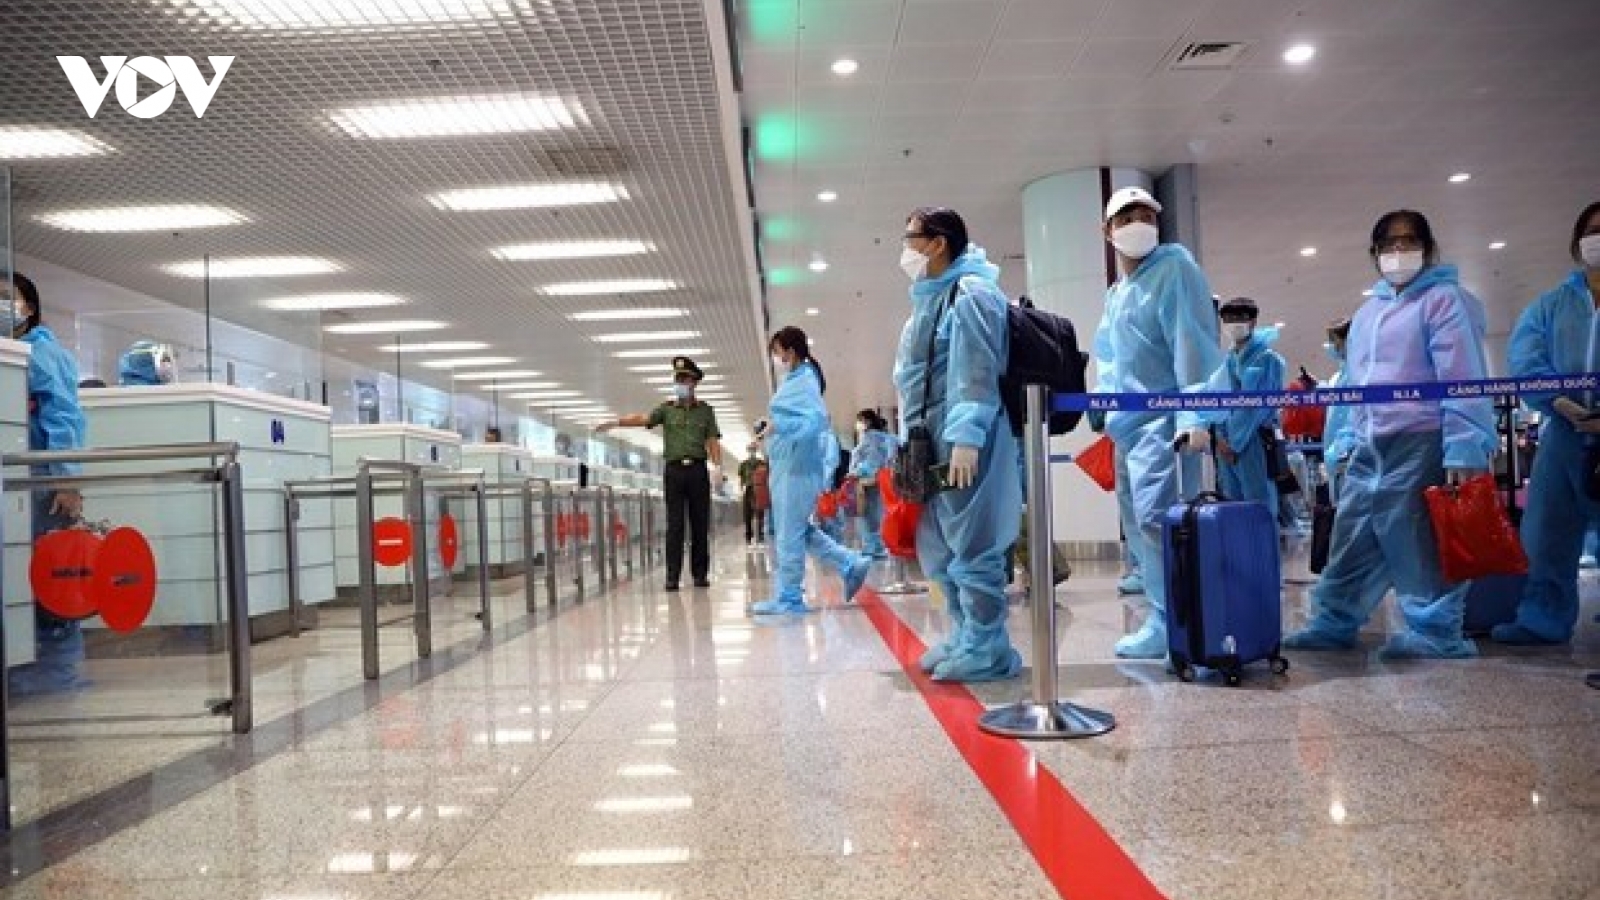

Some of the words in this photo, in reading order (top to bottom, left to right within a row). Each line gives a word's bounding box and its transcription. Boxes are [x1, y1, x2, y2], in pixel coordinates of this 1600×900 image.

[1520, 378, 1561, 391] KHÔNG
[1564, 376, 1596, 389] QUỐC
[1222, 395, 1262, 407] KHÔNG
[1266, 392, 1298, 406] QUỐC
[1303, 391, 1316, 404] TẾ
